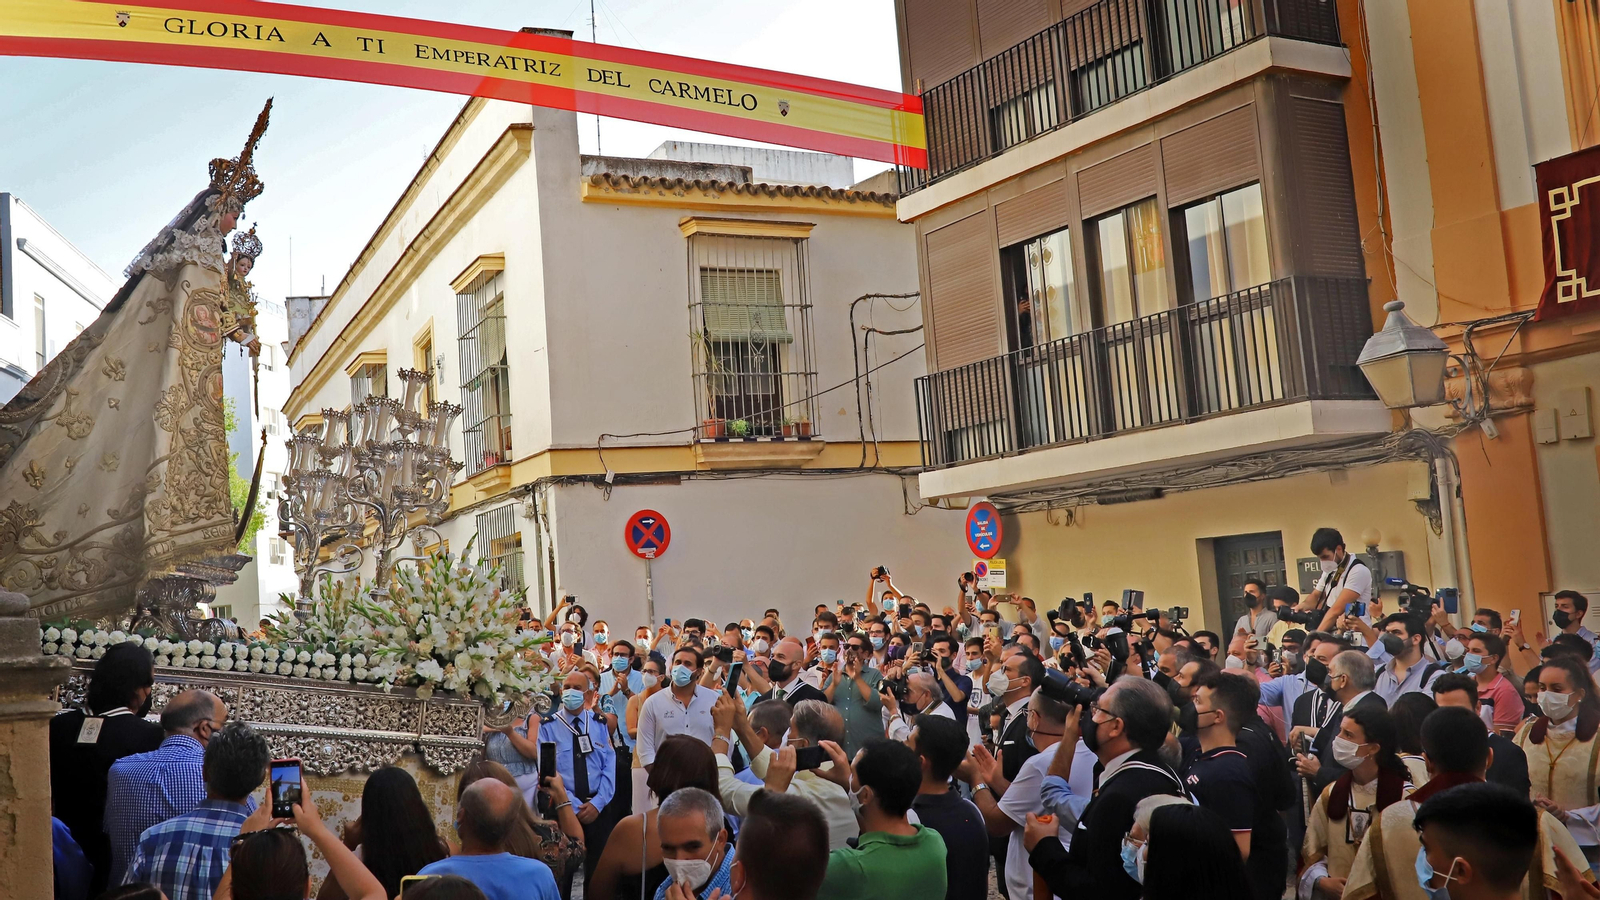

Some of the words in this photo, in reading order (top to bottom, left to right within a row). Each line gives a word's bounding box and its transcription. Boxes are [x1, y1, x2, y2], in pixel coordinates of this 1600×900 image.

[164, 17, 285, 42] GLORIA
[311, 31, 332, 48] A
[356, 36, 386, 54] TI
[414, 43, 562, 77] EMPERATRIZ
[586, 67, 631, 88] DEL
[648, 78, 758, 111] CARMELO
